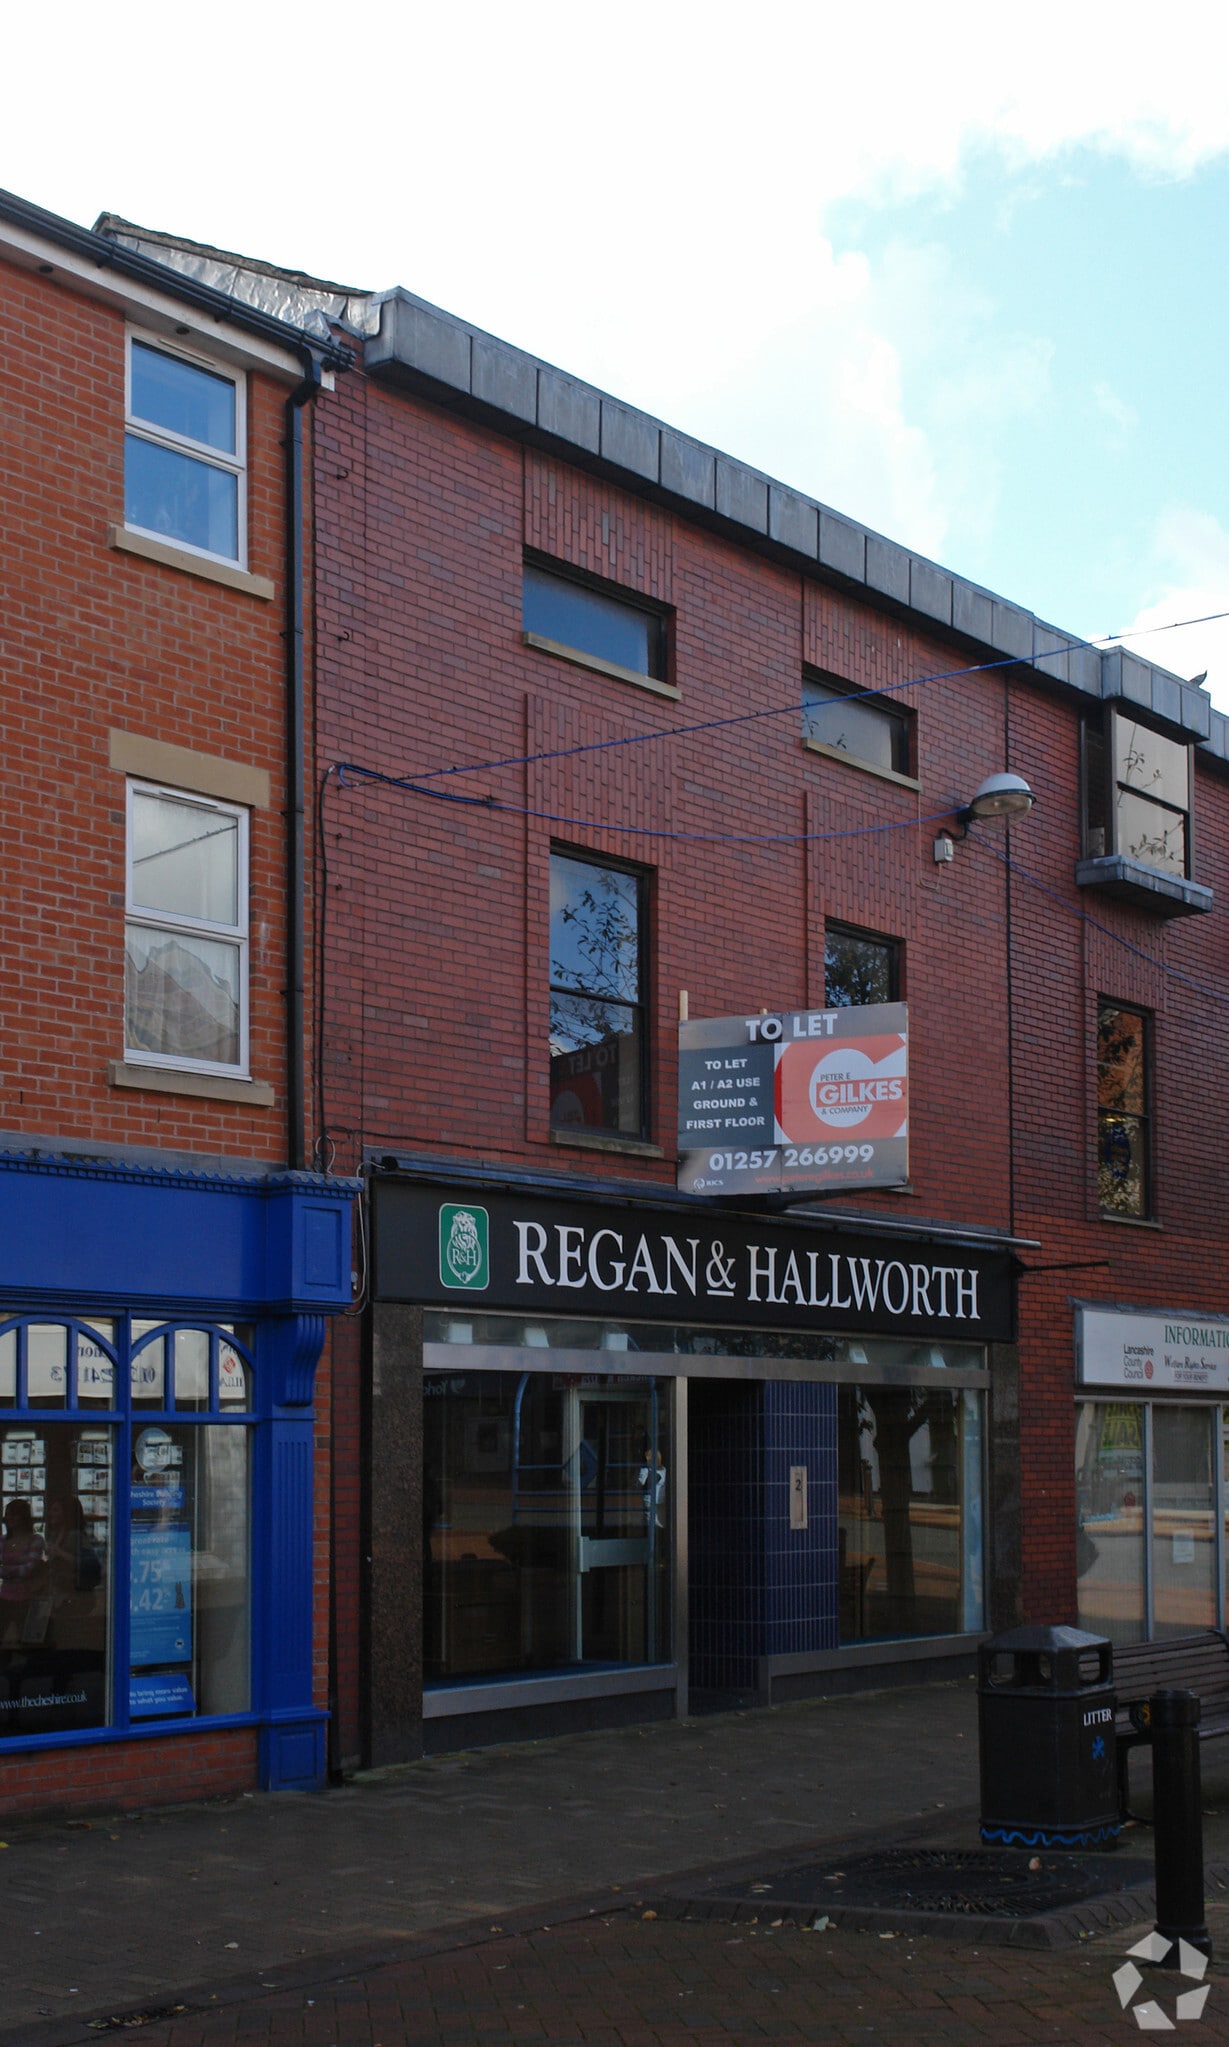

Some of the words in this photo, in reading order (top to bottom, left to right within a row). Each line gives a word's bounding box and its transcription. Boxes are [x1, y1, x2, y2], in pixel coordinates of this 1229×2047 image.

[745, 1019, 783, 1042] TO
[792, 1013, 838, 1038] LET
[705, 1060, 722, 1071] TO
[725, 1058, 748, 1069] LET
[691, 1080, 707, 1091] A1
[717, 1078, 734, 1089] A2
[736, 1076, 761, 1088] USE
[820, 1073, 844, 1082] PETER
[846, 1072, 851, 1080] E
[819, 1080, 903, 1105] GILKES
[693, 1098, 746, 1110] GROUND
[748, 1096, 758, 1107] &
[821, 1107, 828, 1116] &
[829, 1105, 869, 1115] COMPANY
[686, 1118, 722, 1130] FIRST
[724, 1116, 765, 1128] FLOOR
[709, 1150, 778, 1171] 01257
[784, 1144, 875, 1168] 266999
[452, 1248, 477, 1266] R&H
[512, 1220, 700, 1297] REGAN
[706, 1240, 736, 1297] &
[746, 1244, 981, 1320] HALLWORTH
[1123, 1343, 1155, 1356] Lancashire
[1123, 1355, 1143, 1369] County
[1123, 1367, 1144, 1379] Council
[795, 1480, 802, 1492] 2
[130, 1489, 154, 1498] heshire
[1084, 1708, 1112, 1726] LITTER
